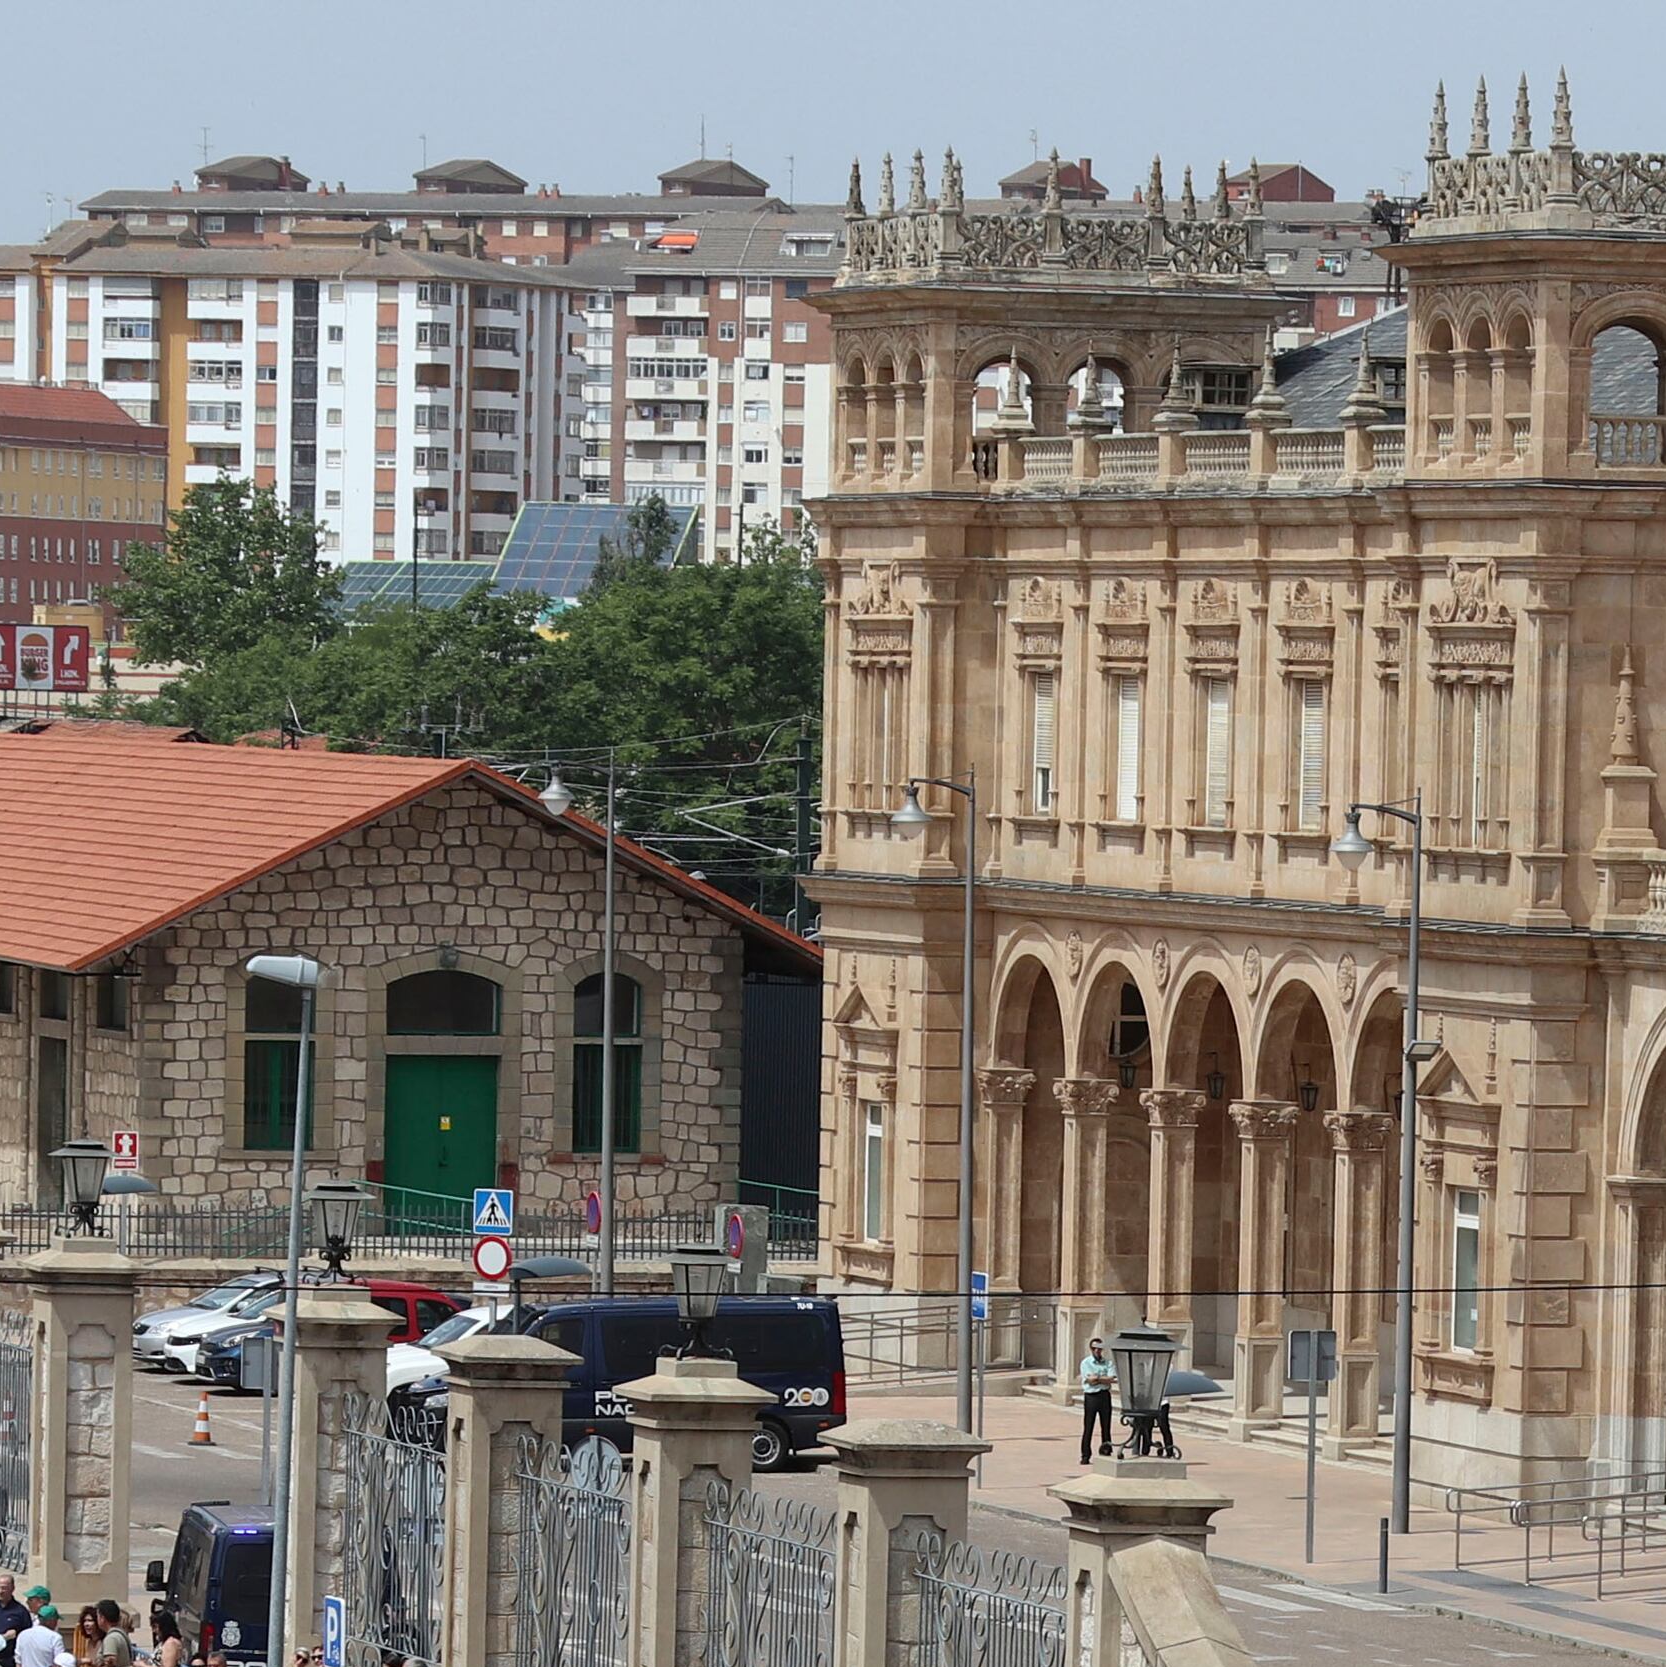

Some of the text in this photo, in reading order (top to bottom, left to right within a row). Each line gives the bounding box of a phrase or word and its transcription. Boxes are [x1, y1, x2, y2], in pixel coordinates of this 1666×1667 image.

[21, 648, 49, 657] BURGER
[784, 1387, 829, 1407] 200
[327, 1606, 338, 1659] P
